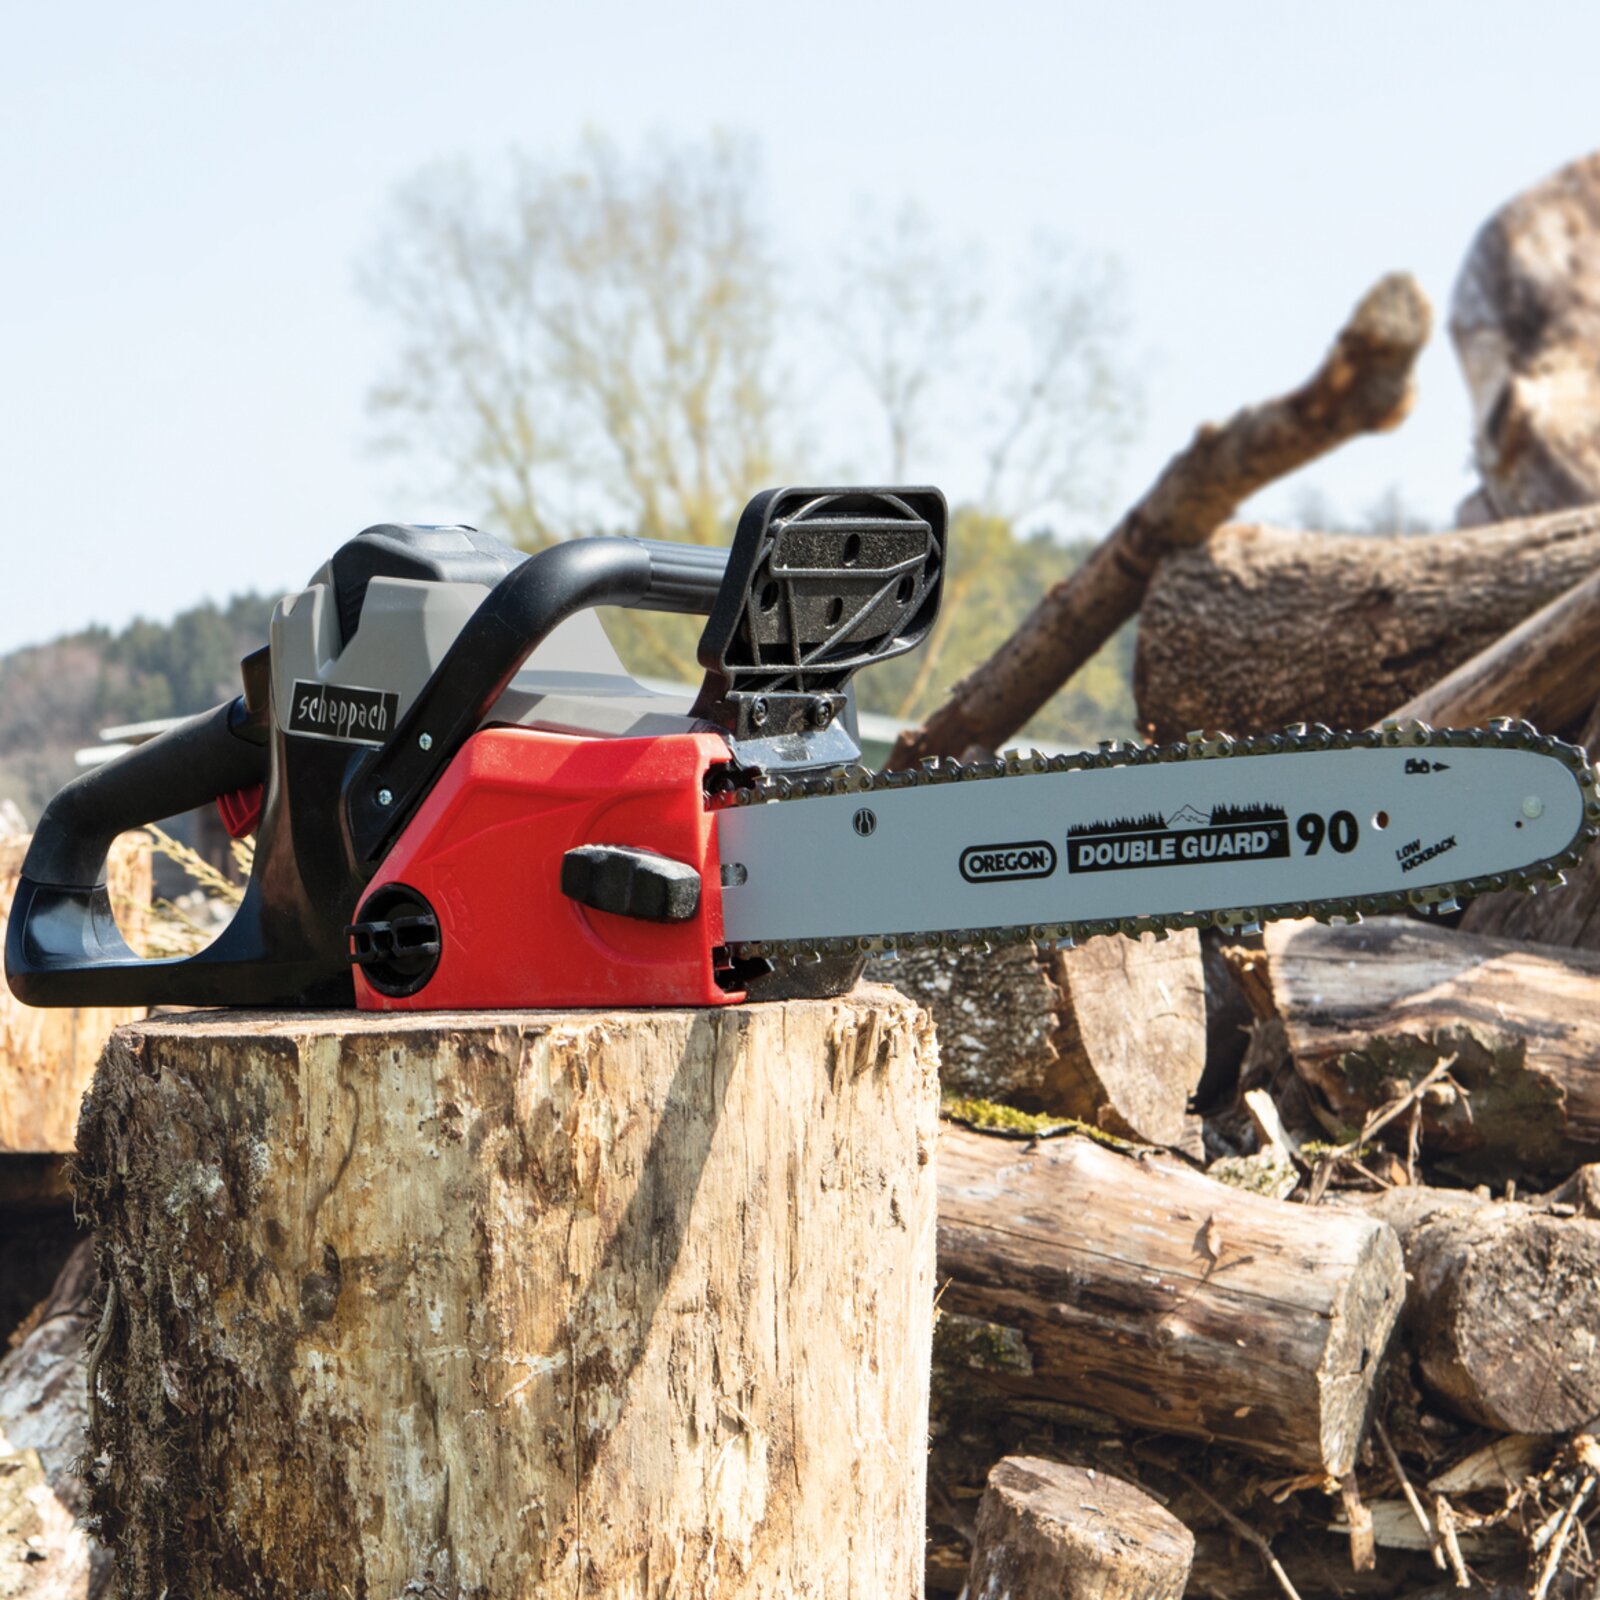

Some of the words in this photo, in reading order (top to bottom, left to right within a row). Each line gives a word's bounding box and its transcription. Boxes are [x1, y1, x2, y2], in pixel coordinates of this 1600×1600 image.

[298, 684, 387, 737] scheppach
[1078, 839, 1176, 866] DOUBLE
[1296, 810, 1359, 856] 90
[1395, 838, 1421, 861] LOW
[1401, 835, 1457, 873] KICKBACK
[969, 850, 1046, 874] OREGON
